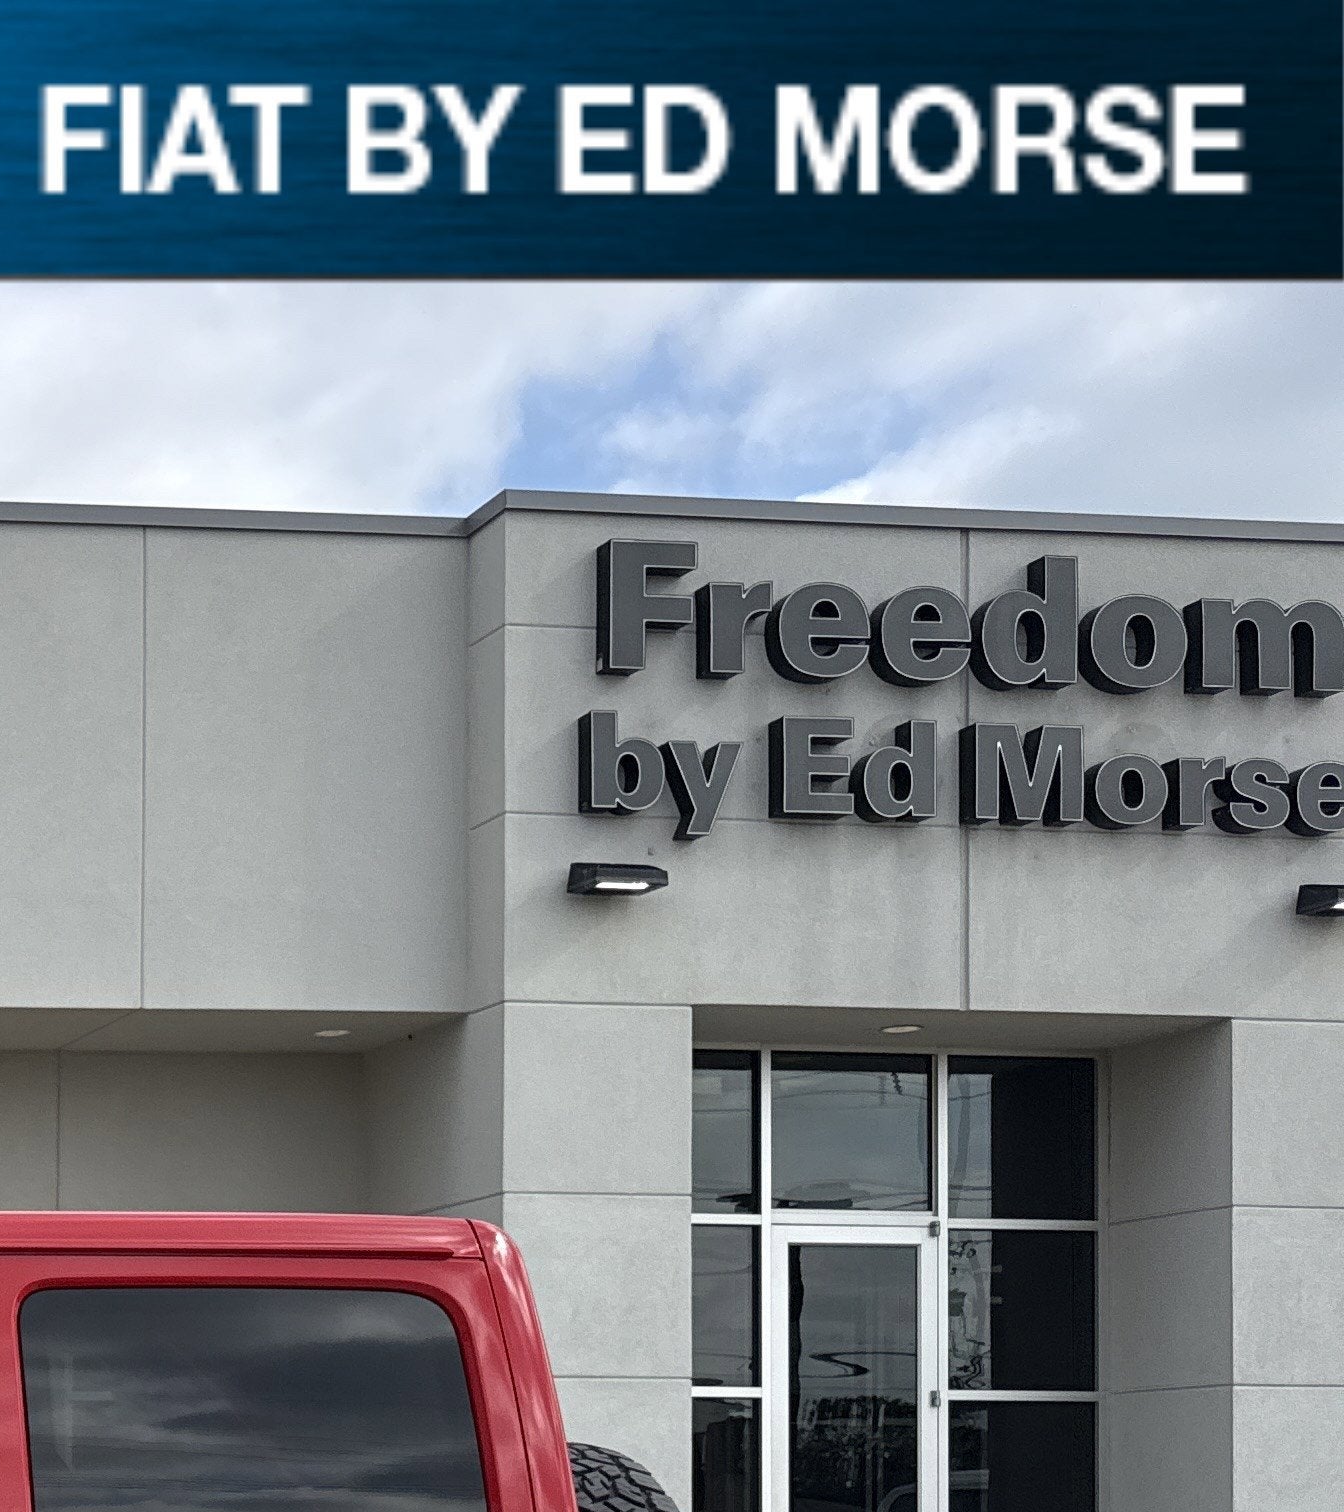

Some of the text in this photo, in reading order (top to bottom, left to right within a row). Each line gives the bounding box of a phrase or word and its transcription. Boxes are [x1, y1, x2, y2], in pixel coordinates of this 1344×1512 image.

[596, 538, 1344, 697] Freedom
[578, 709, 1344, 840] by Ed Morse
